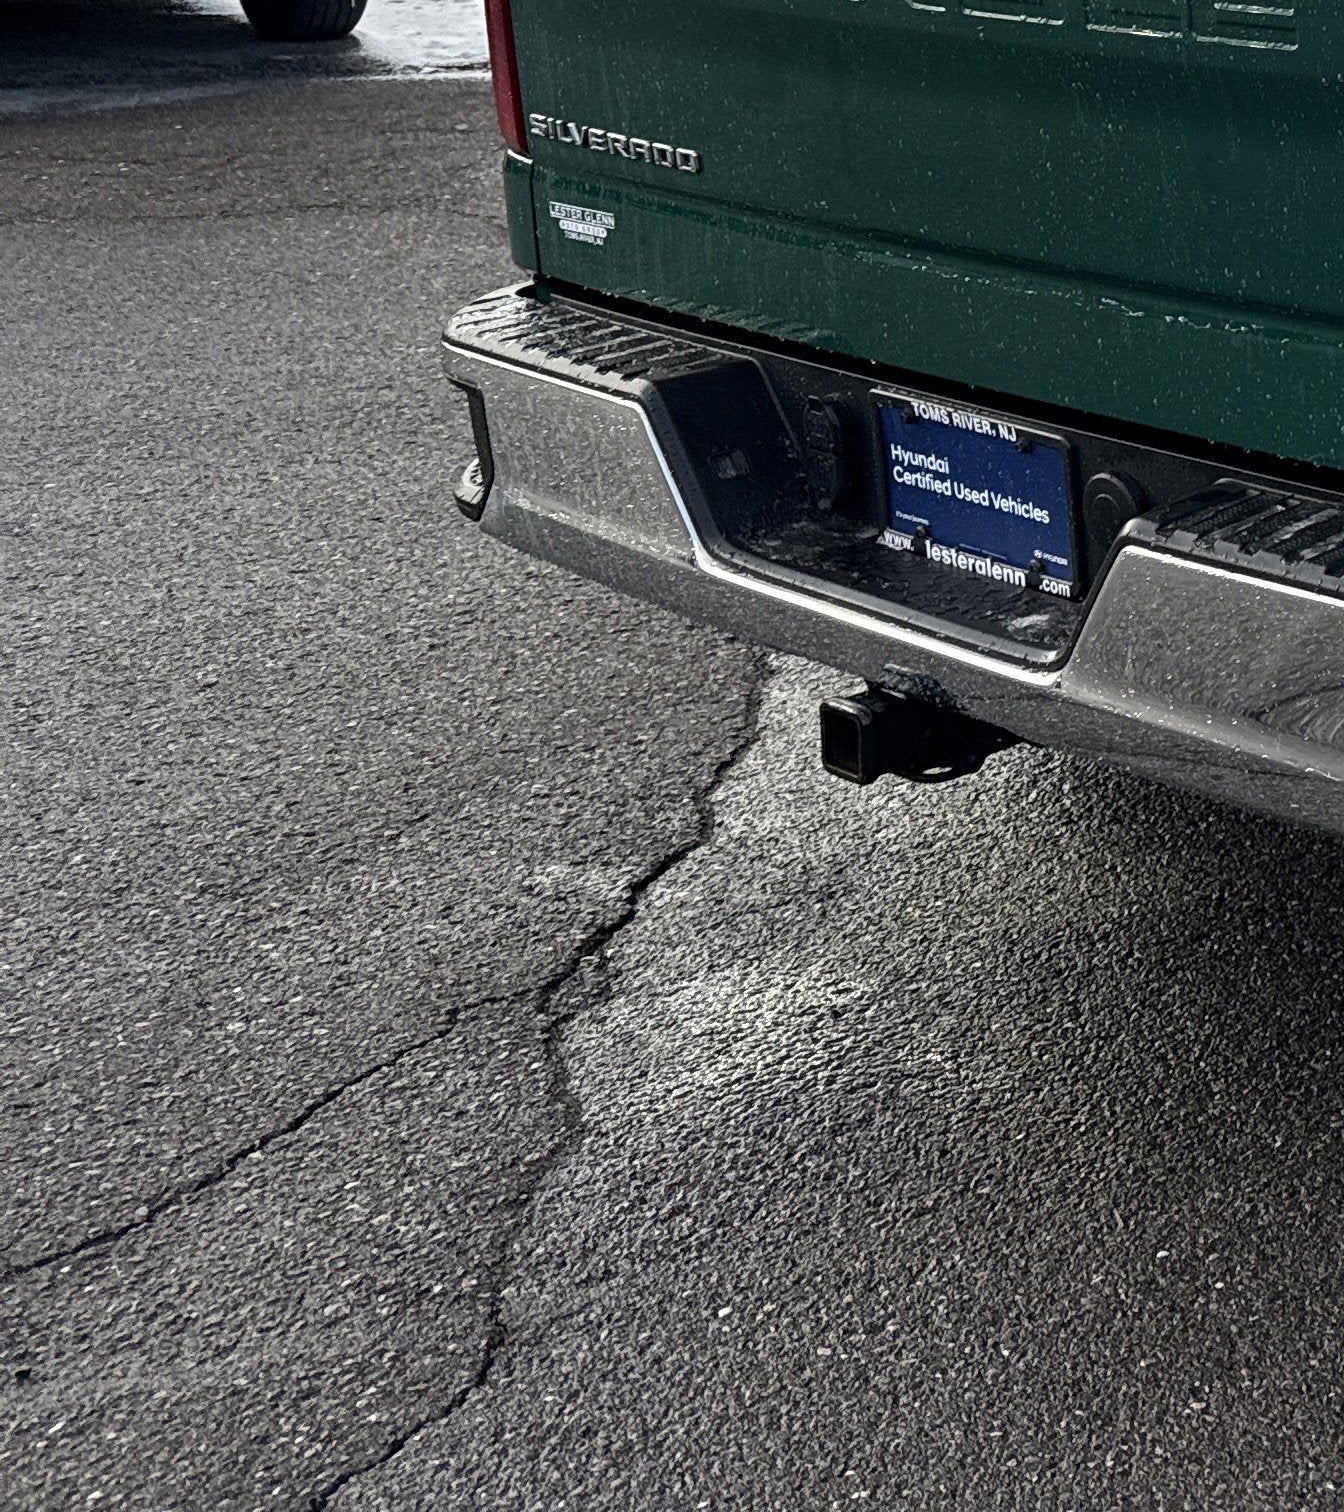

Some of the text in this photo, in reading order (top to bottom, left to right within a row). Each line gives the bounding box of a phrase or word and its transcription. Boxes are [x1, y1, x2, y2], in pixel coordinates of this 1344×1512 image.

[529, 113, 699, 173] SILVERADO
[549, 203, 615, 226] LESTER GLENN
[911, 401, 1017, 442] TOMS RIVER, NJ
[890, 443, 949, 474] Hyundai
[893, 466, 1050, 524] Certified Used Vehicles
[1038, 578, 1071, 598] .com
